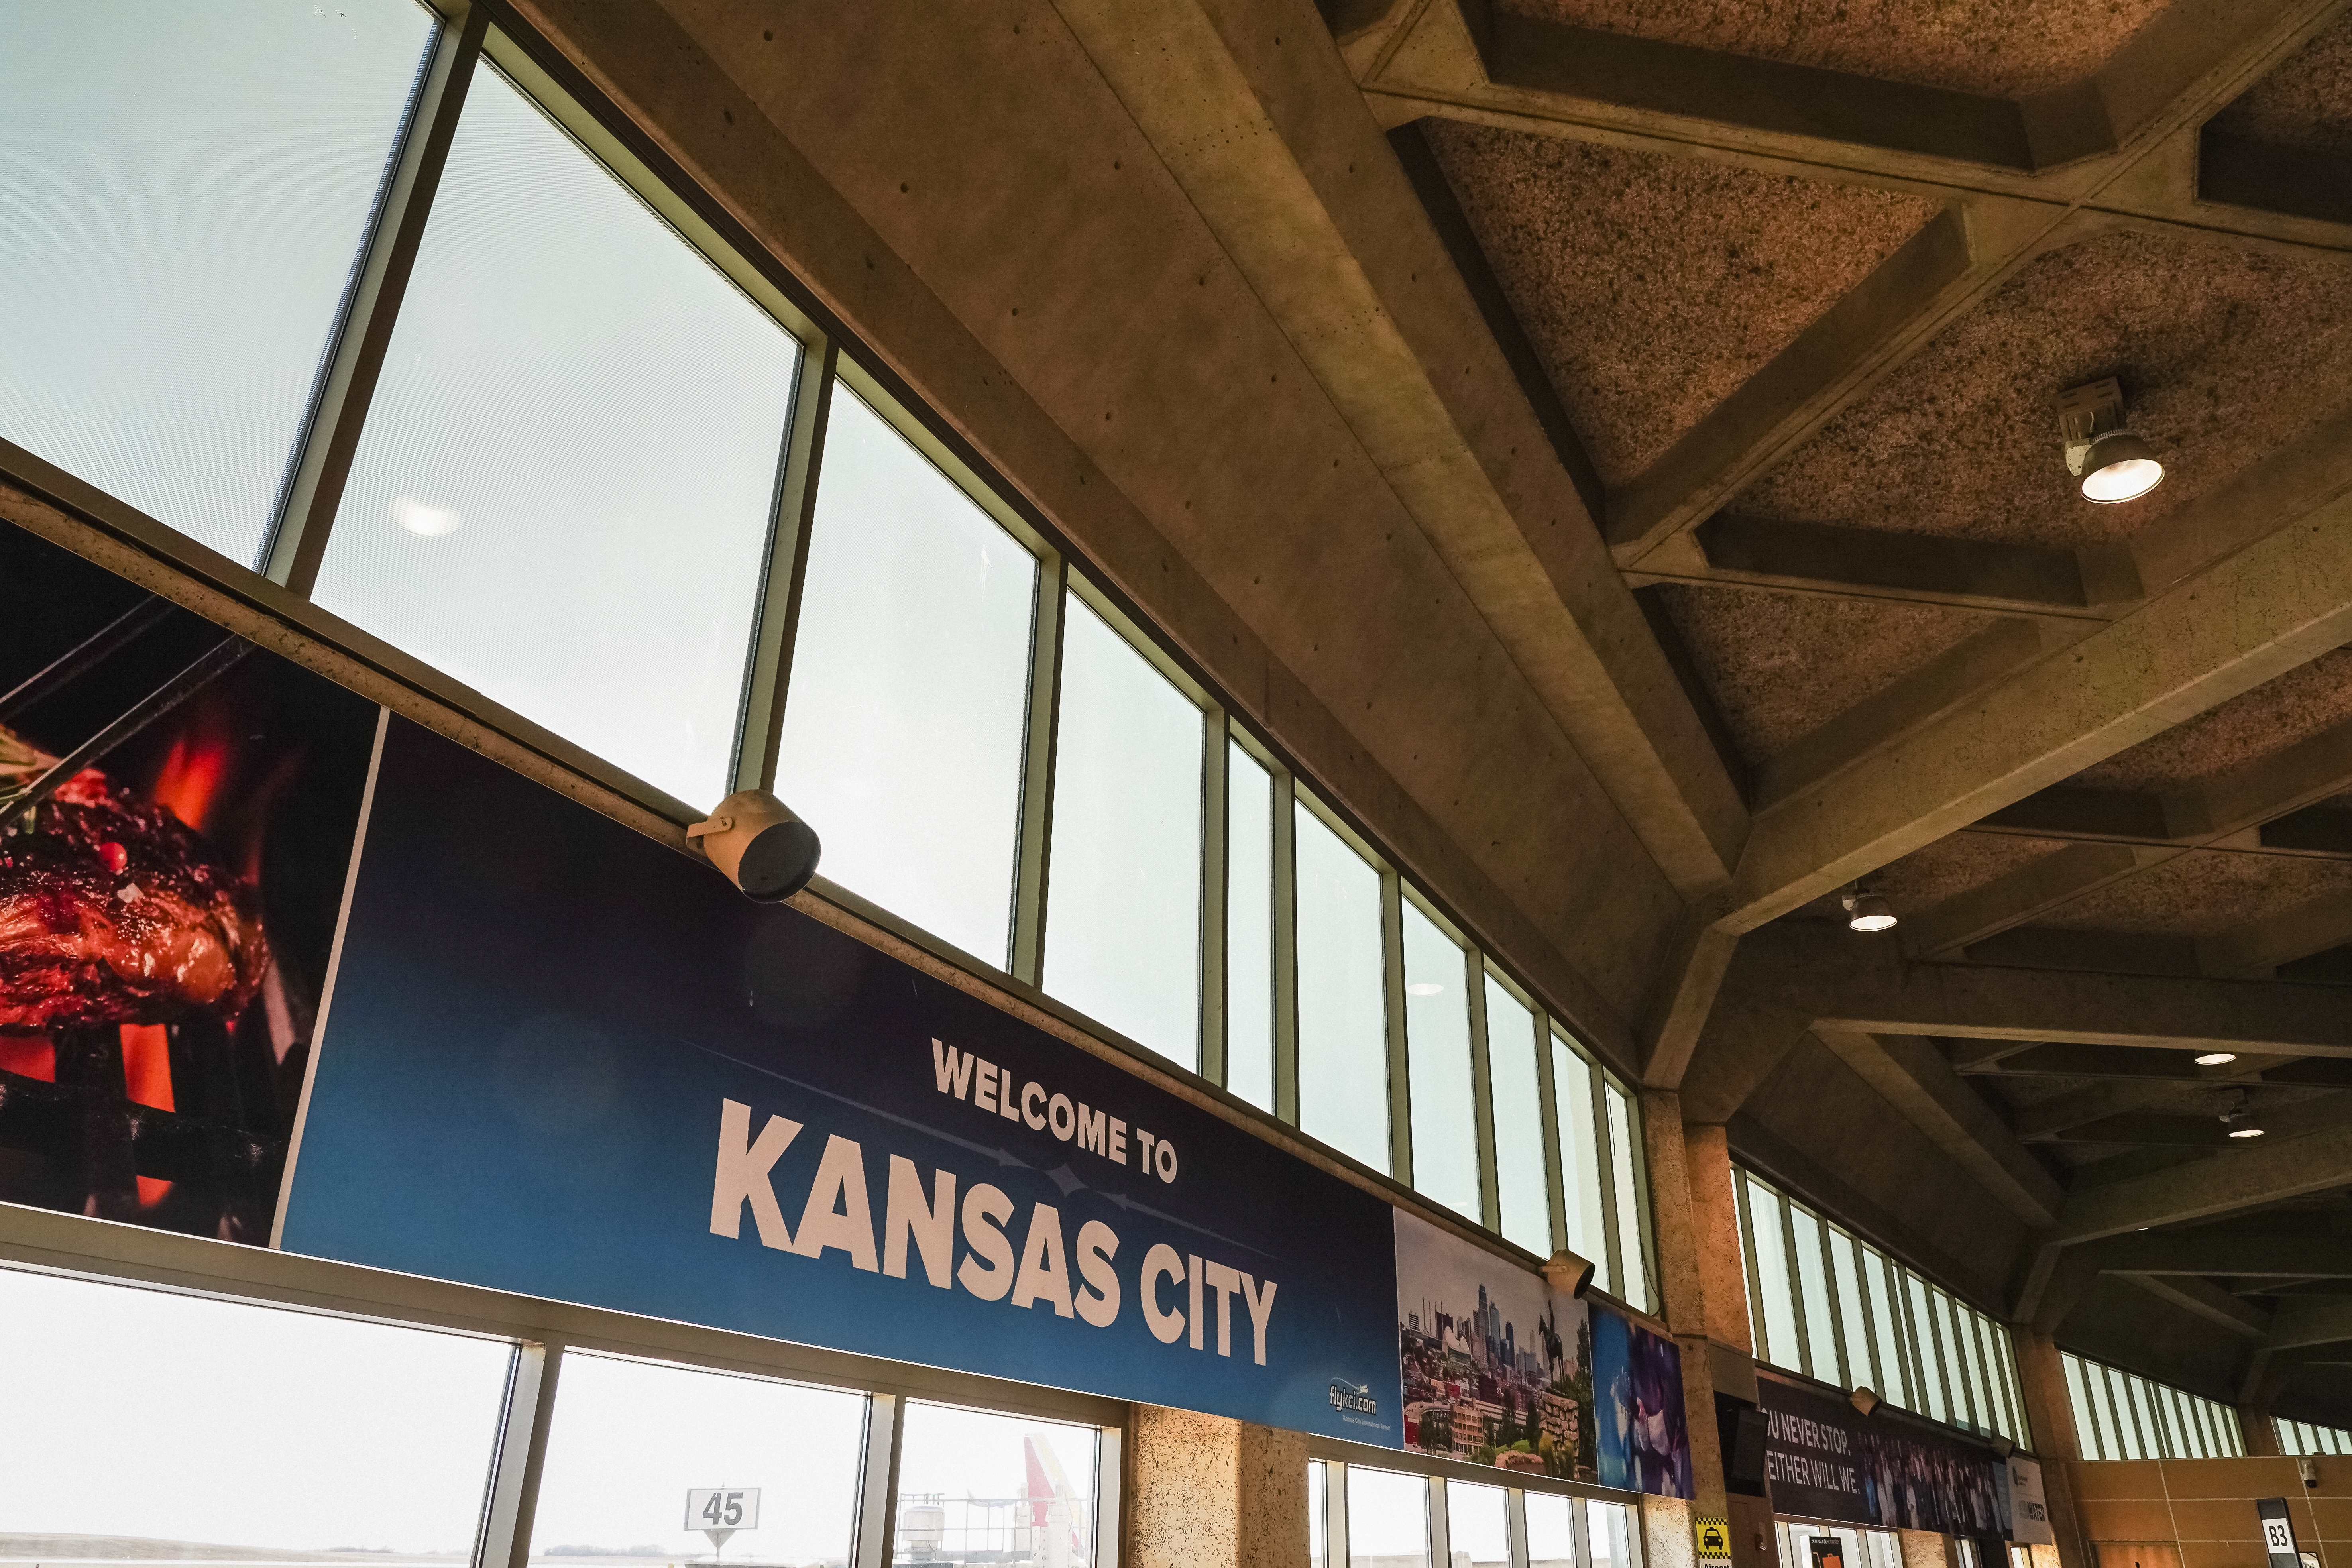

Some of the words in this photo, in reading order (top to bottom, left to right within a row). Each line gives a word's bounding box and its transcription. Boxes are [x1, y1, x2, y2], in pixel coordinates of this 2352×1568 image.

[932, 1037, 1126, 1165] WELCOME
[1137, 1128, 1177, 1183] TO
[710, 1098, 1120, 1327] KANSAS
[1140, 1243, 1277, 1366] CITY
[1330, 1385, 1376, 1414] flykci.com
[1781, 1413, 1820, 1449] NEVER
[1821, 1424, 1851, 1456] STOP.
[1810, 1459, 1839, 1491] WILL
[1838, 1465, 1860, 1494] WE.
[703, 1492, 743, 1525] 45
[2269, 1525, 2288, 1547] B3
